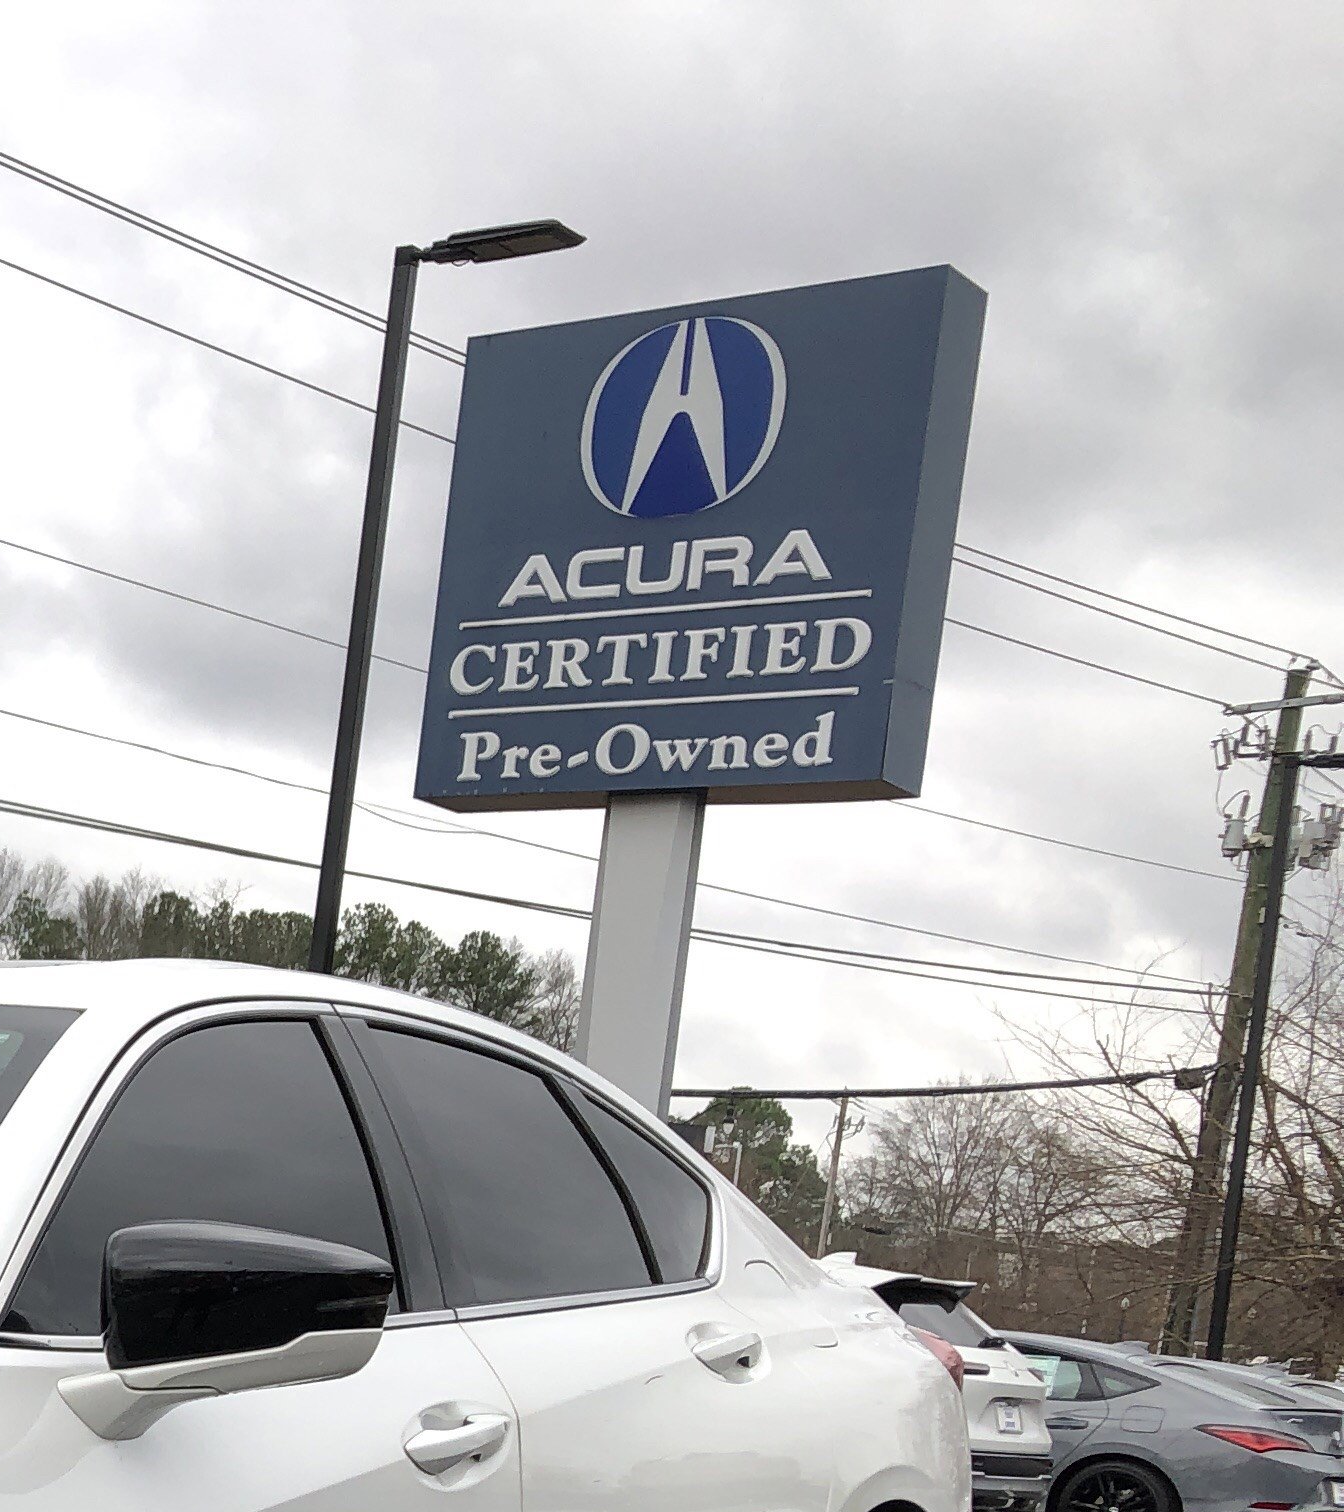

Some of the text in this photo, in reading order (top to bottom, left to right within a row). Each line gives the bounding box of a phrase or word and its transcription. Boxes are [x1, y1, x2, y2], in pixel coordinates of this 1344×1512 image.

[498, 529, 832, 607] ACURA
[449, 617, 872, 696] CERTIFIED
[457, 711, 836, 783] Pre-Owned
